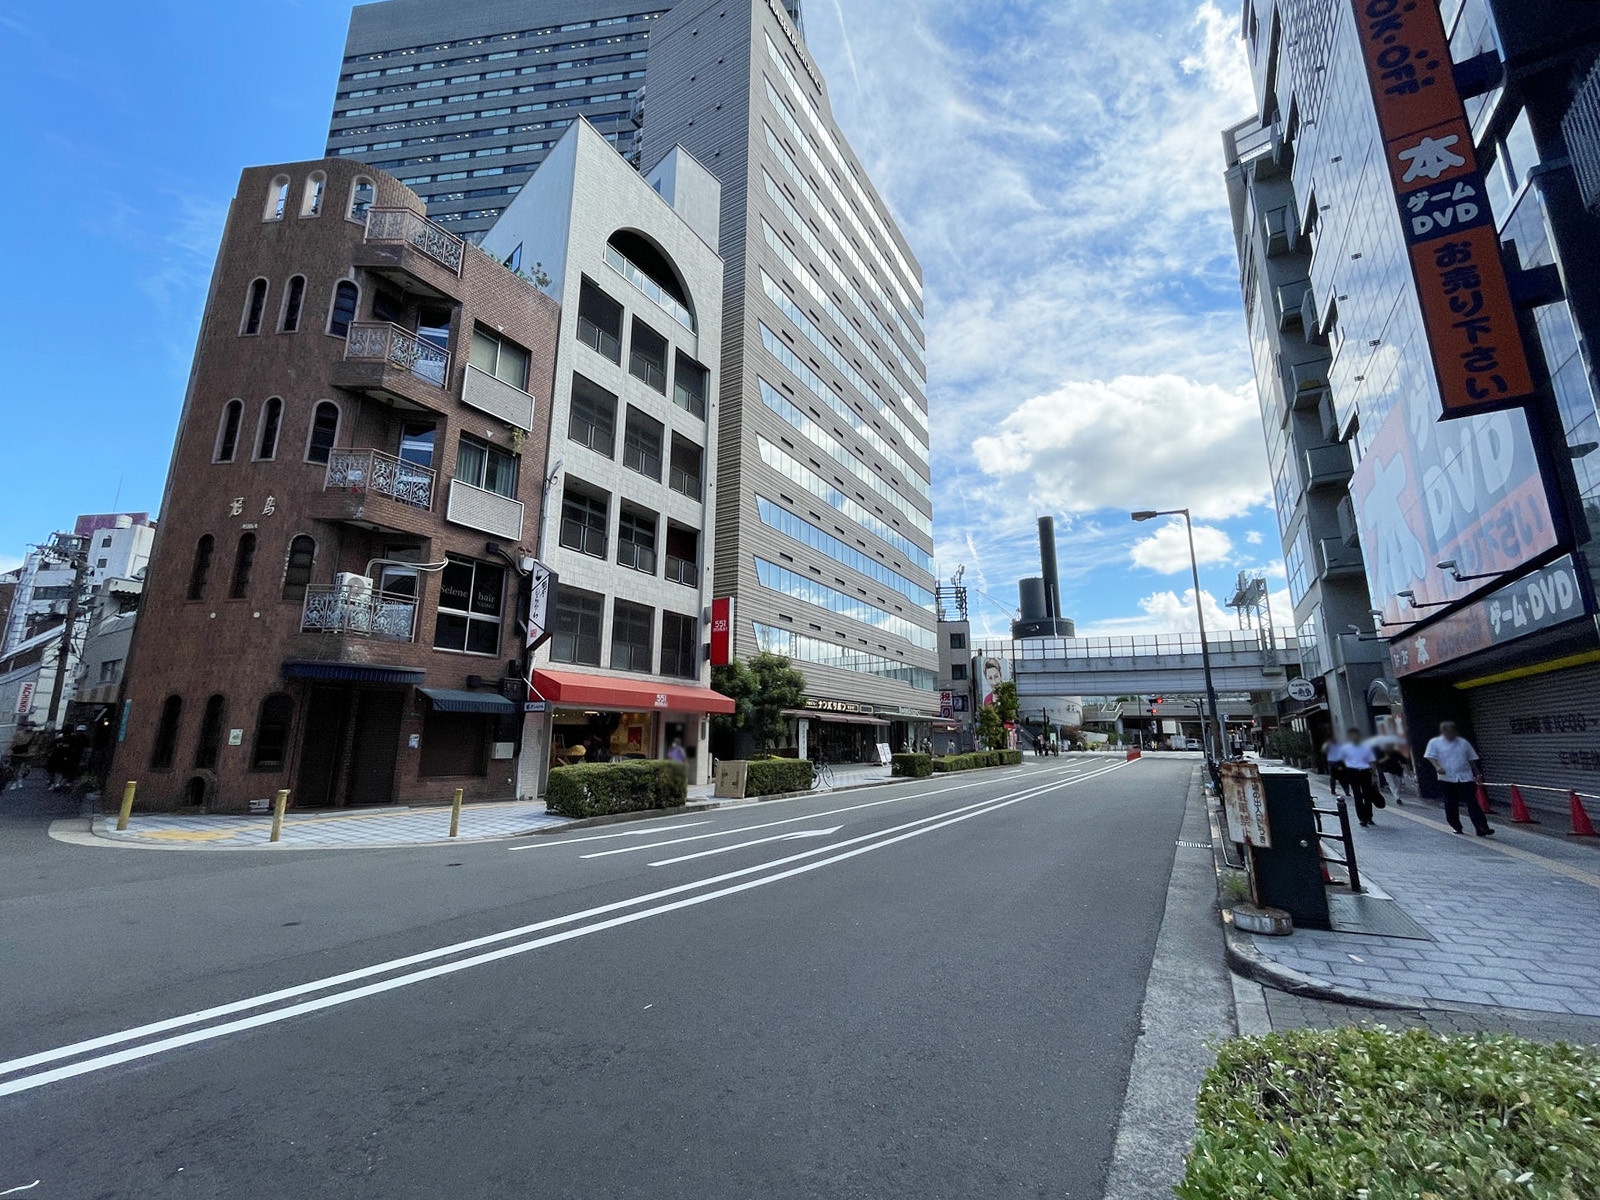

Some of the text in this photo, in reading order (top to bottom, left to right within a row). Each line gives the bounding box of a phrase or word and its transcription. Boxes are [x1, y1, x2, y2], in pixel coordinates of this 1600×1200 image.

[1398, 134, 1466, 183] 本
[1406, 181, 1477, 213] ゲーム
[1411, 202, 1479, 236] DVD
[1434, 240, 1508, 400] お売り下さい
[1423, 411, 1514, 541] DVD
[714, 619, 726, 628] 551
[18, 683, 33, 713] PACHINKO
[656, 694, 667, 702] 551
